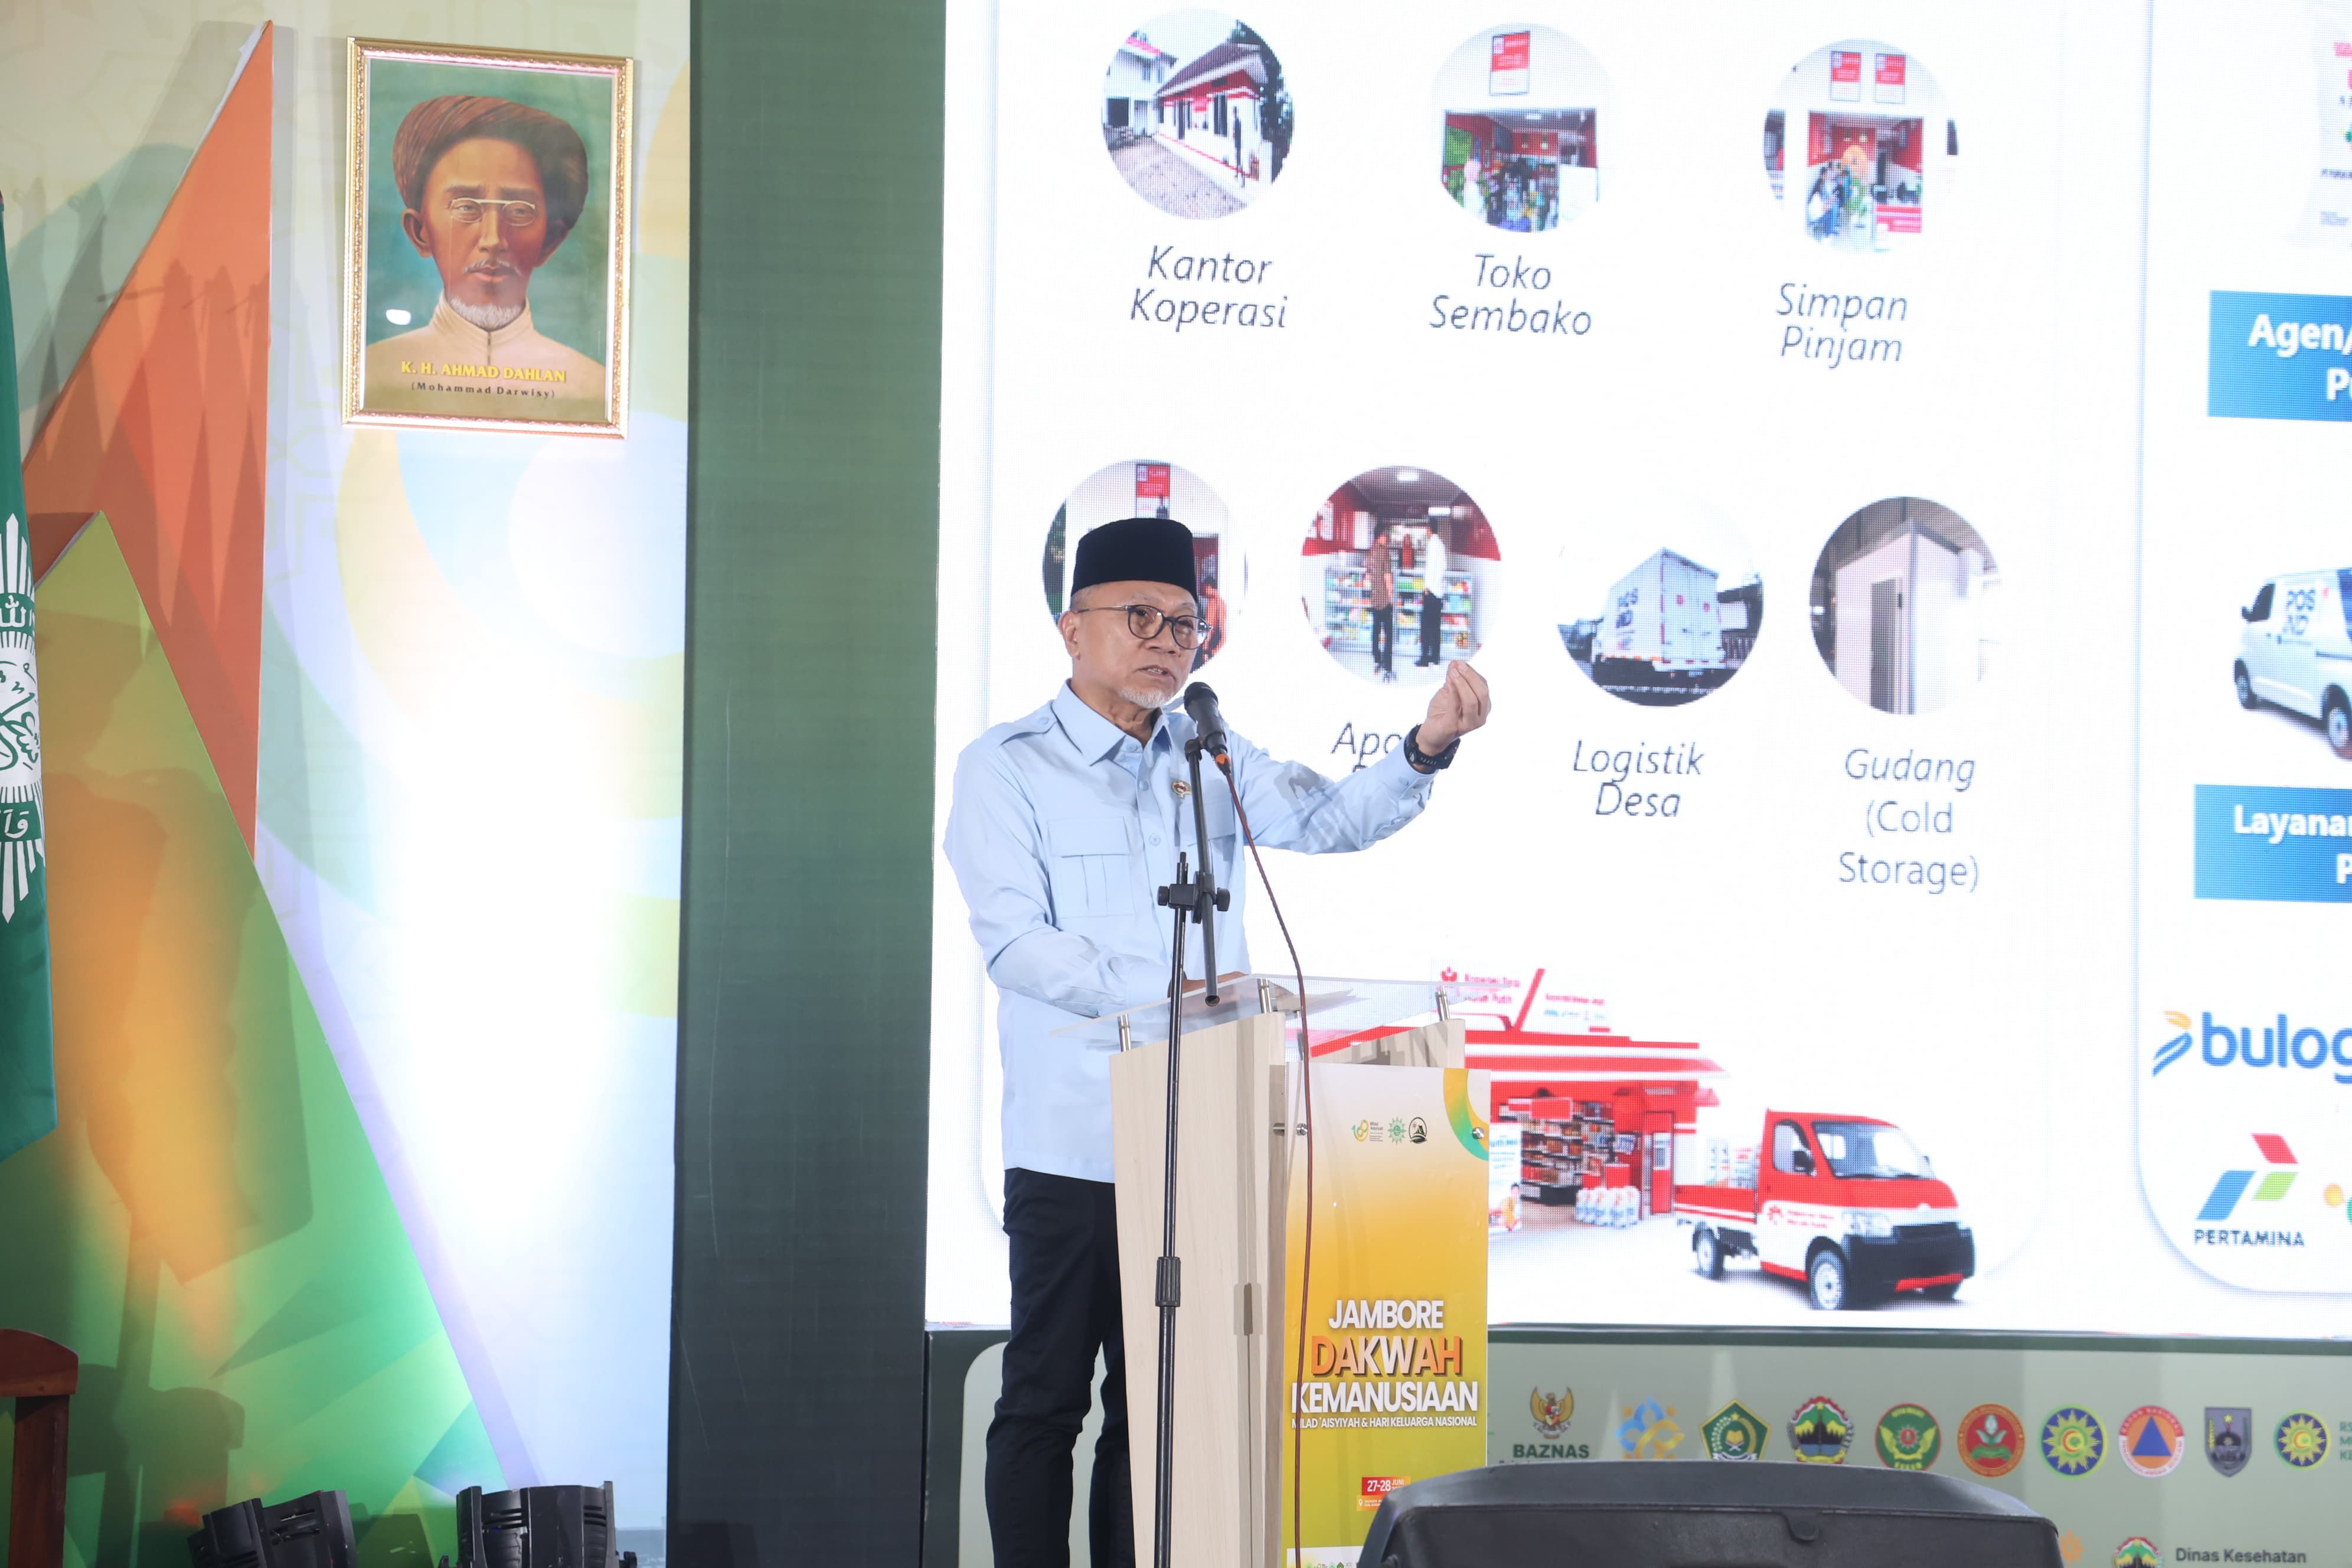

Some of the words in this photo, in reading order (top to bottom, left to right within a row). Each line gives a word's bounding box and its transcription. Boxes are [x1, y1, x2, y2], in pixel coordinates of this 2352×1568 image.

[1149, 246, 1273, 283] Kantor
[1474, 253, 1551, 290] Toko
[1131, 288, 1289, 332] Koperasi
[1429, 295, 1592, 336] Sembako
[1776, 282, 1909, 331] Simpan
[1780, 326, 1903, 369] Pinjam
[401, 361, 417, 373] K.
[421, 362, 437, 375] H.
[441, 364, 499, 378] AHMAD
[503, 367, 566, 382] DAHLAN
[411, 382, 491, 394] (Mohammad
[496, 387, 554, 399] Darwisy)
[1331, 721, 1402, 766] Apo
[1573, 740, 1705, 782] Logistik
[1845, 749, 1976, 792] Gudang
[1596, 782, 1681, 817] Desa
[1867, 800, 1954, 838] (Cold
[1840, 852, 1979, 894] Storage)
[2201, 1011, 2352, 1084] bulog
[2194, 1229, 2305, 1247] PERTAMINA
[1328, 1299, 1443, 1329] JAMBORE
[1311, 1335, 1462, 1377] DAKWAH
[1291, 1381, 1478, 1413] KEMANUSIAAN
[1361, 1418, 1368, 1427] &
[1370, 1417, 1389, 1427] HARI
[1391, 1417, 1434, 1427] KELUARGA
[1436, 1416, 1477, 1426] NASIONAL
[1513, 1444, 1589, 1458] BAZNAS
[1367, 1480, 1391, 1492] 27-28
[2176, 1547, 2219, 1562] Dinas
[2224, 1549, 2307, 1563] Kesehatan
